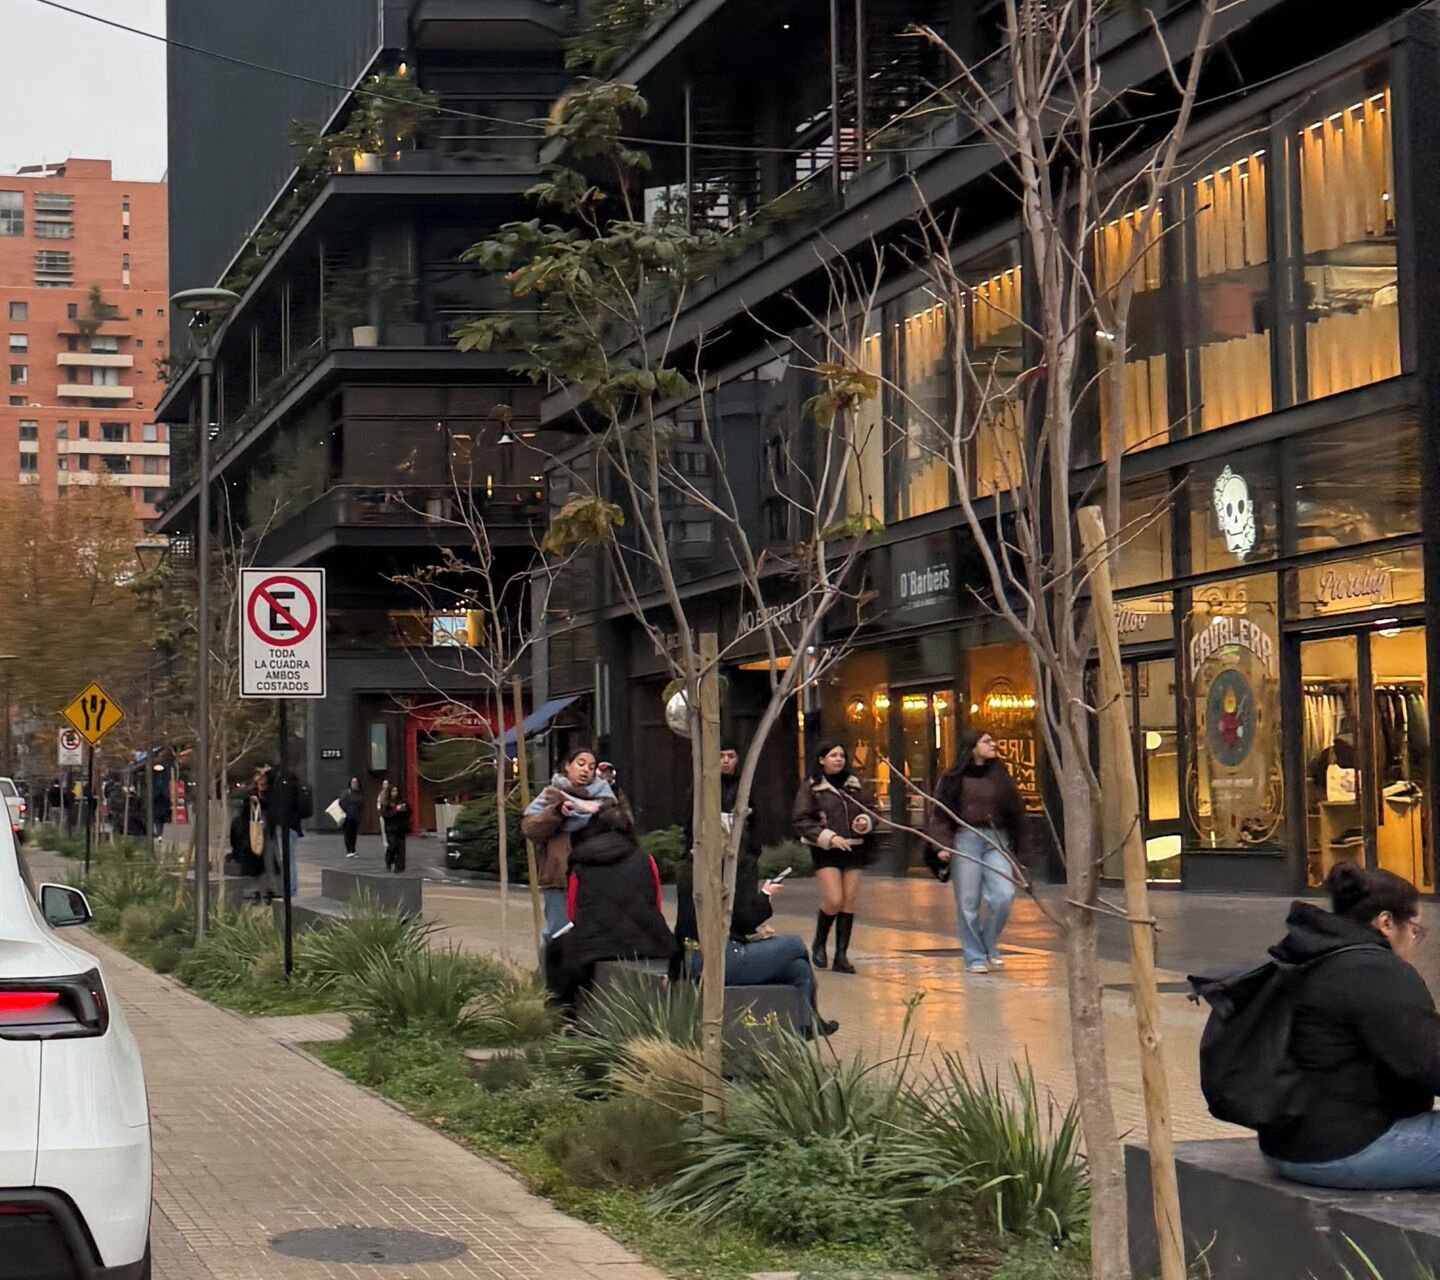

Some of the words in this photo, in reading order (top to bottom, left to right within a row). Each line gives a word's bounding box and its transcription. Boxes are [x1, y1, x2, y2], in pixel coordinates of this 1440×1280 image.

[269, 649, 296, 659] TODA
[254, 659, 267, 669] LA
[269, 659, 310, 669] CUADRA
[265, 670, 301, 680] AMBOS
[256, 681, 309, 691] COSTADOS
